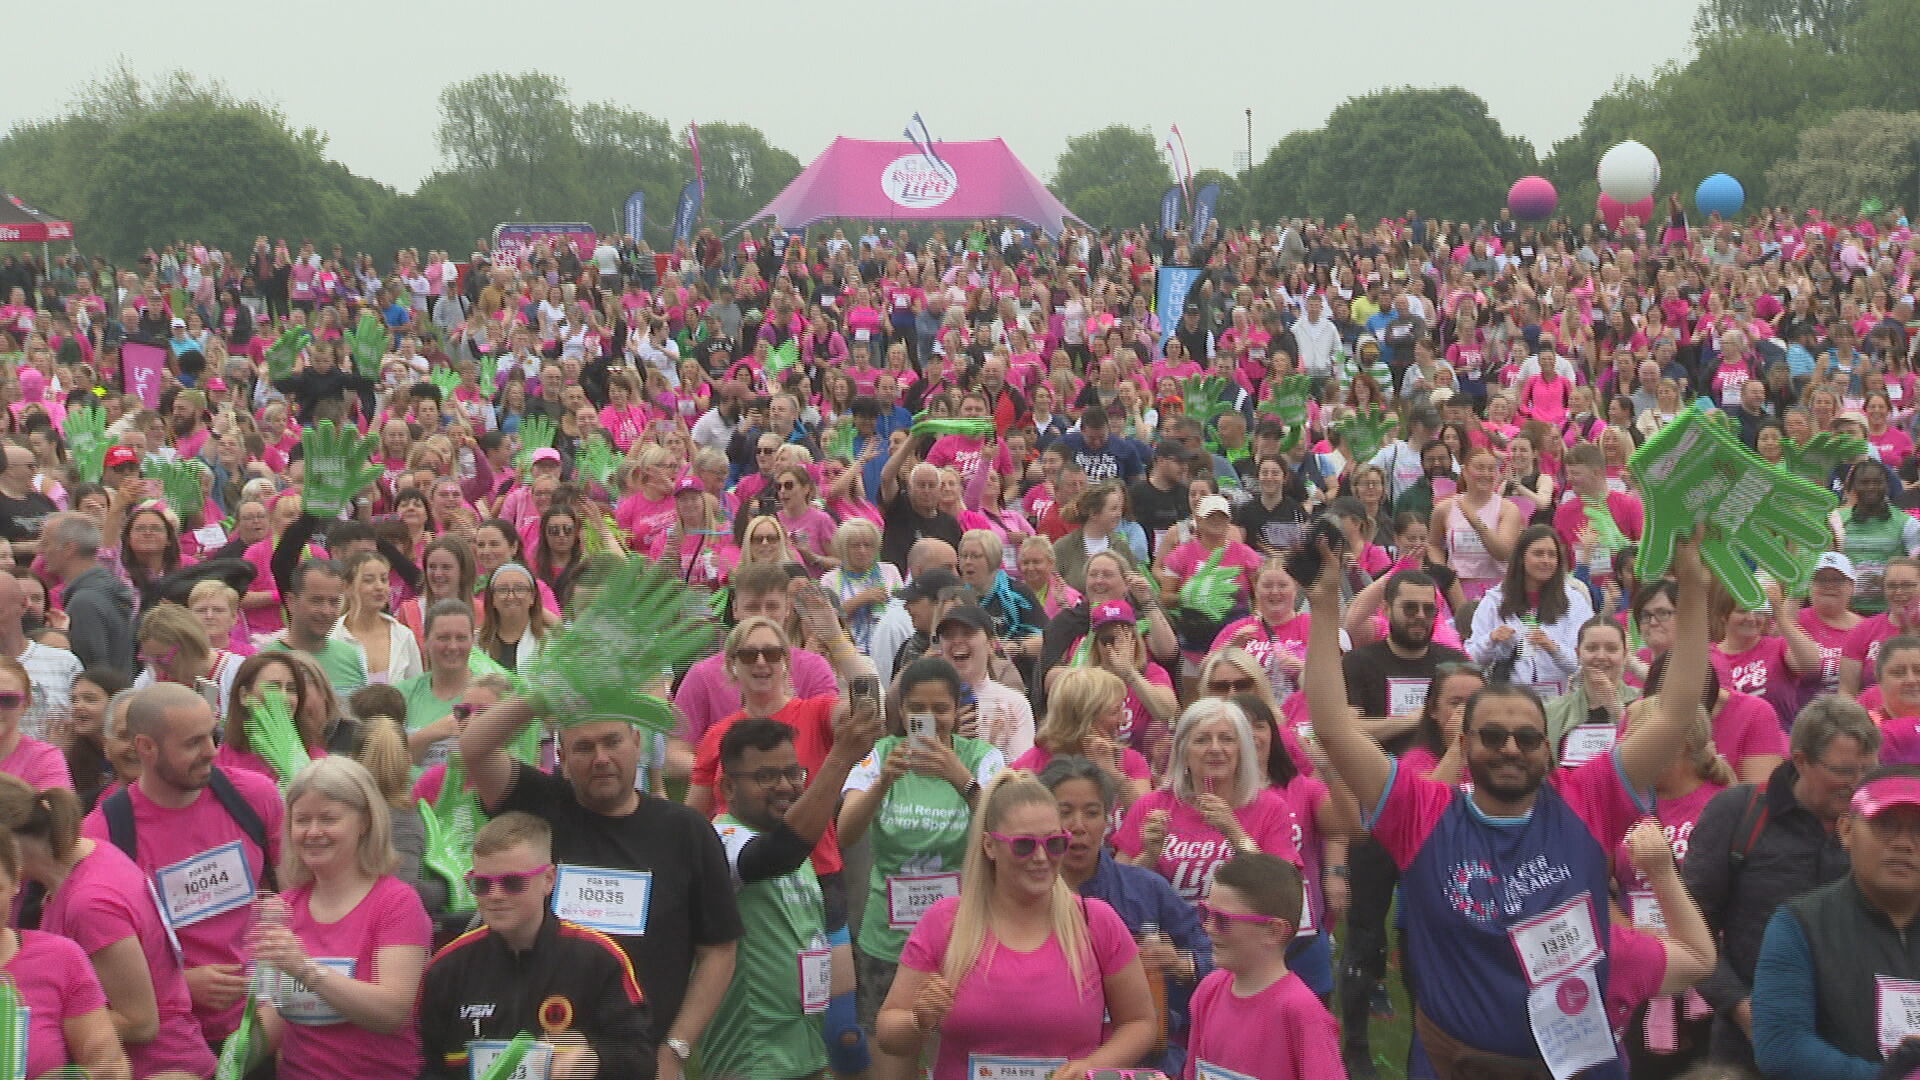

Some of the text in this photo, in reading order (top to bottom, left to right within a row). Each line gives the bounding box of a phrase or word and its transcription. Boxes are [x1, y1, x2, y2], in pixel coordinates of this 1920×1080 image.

[901, 179, 951, 199] Life
[1160, 834, 1215, 861] Race
[183, 870, 229, 897] 10044
[1170, 859, 1225, 898] Lif
[577, 887, 625, 905] 10035
[461, 1003, 496, 1019] VSN
